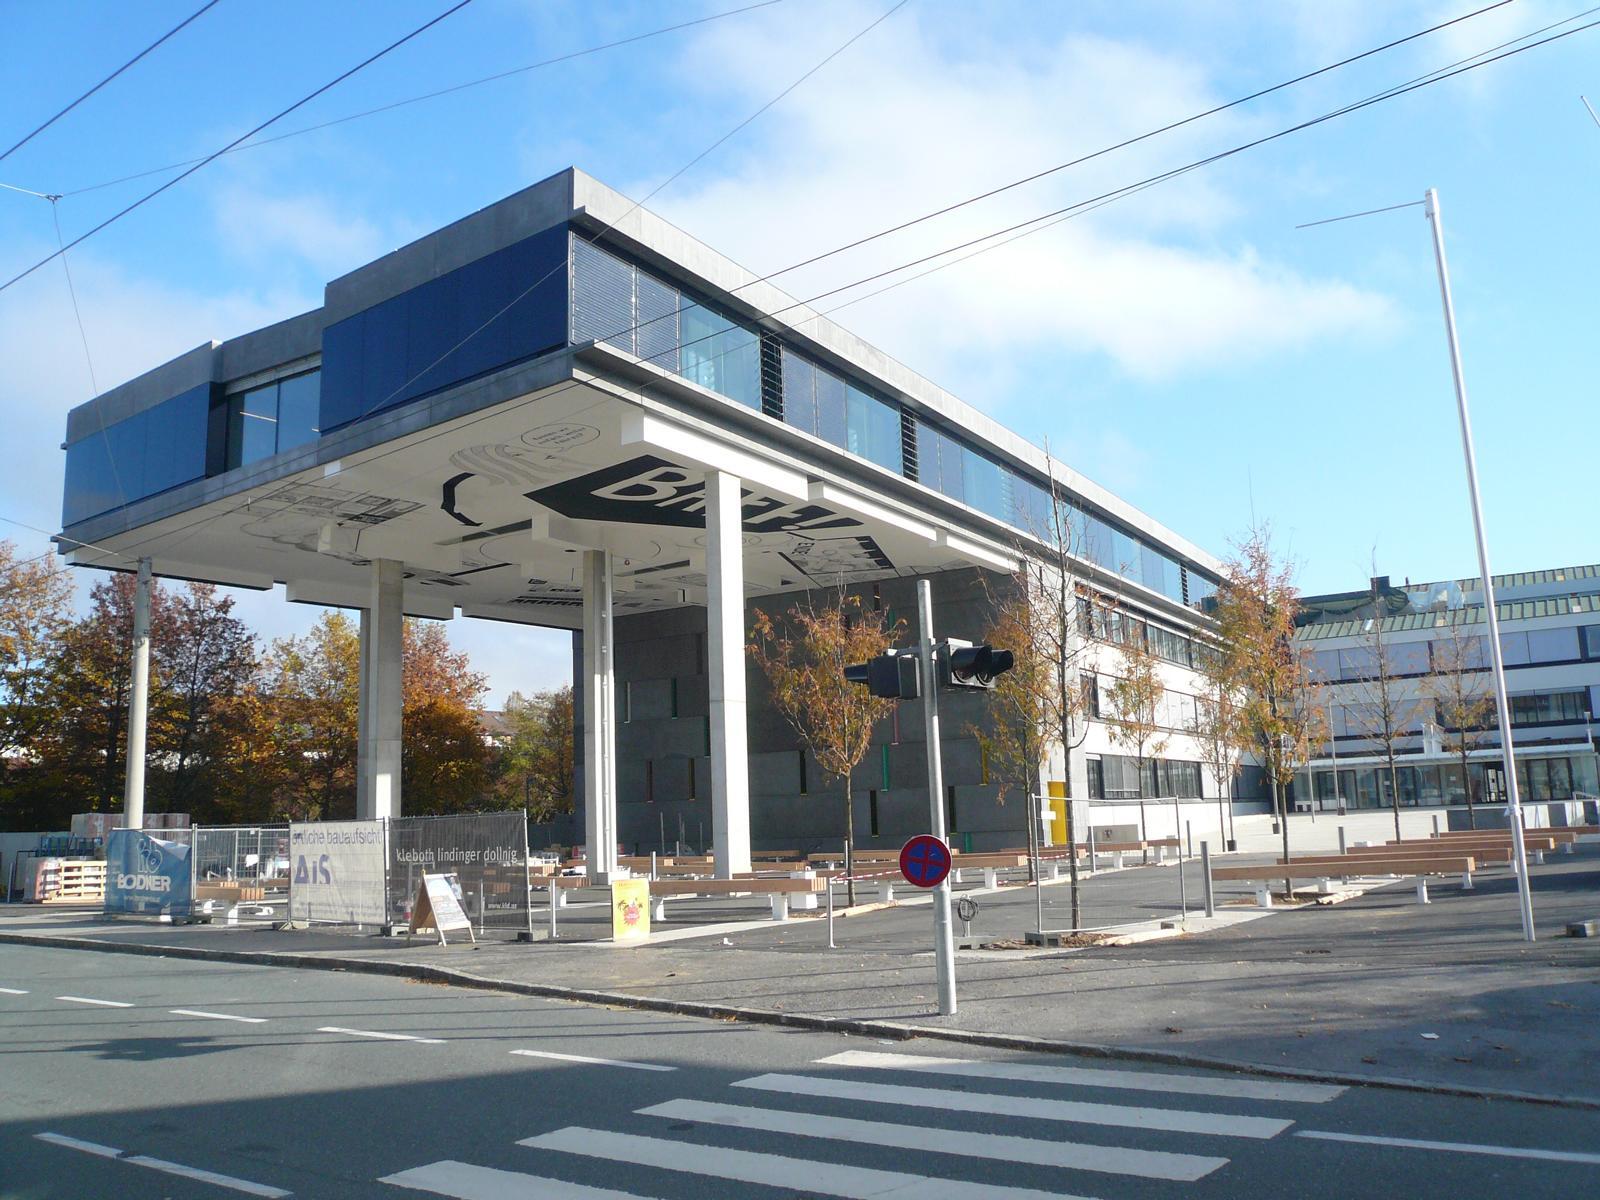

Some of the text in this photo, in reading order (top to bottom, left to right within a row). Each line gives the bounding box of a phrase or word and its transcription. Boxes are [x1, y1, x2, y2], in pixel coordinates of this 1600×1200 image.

[328, 828, 383, 845] bauaufsicht
[396, 846, 518, 864] kleboth lindinger dollnig
[117, 874, 171, 892] BODNER
